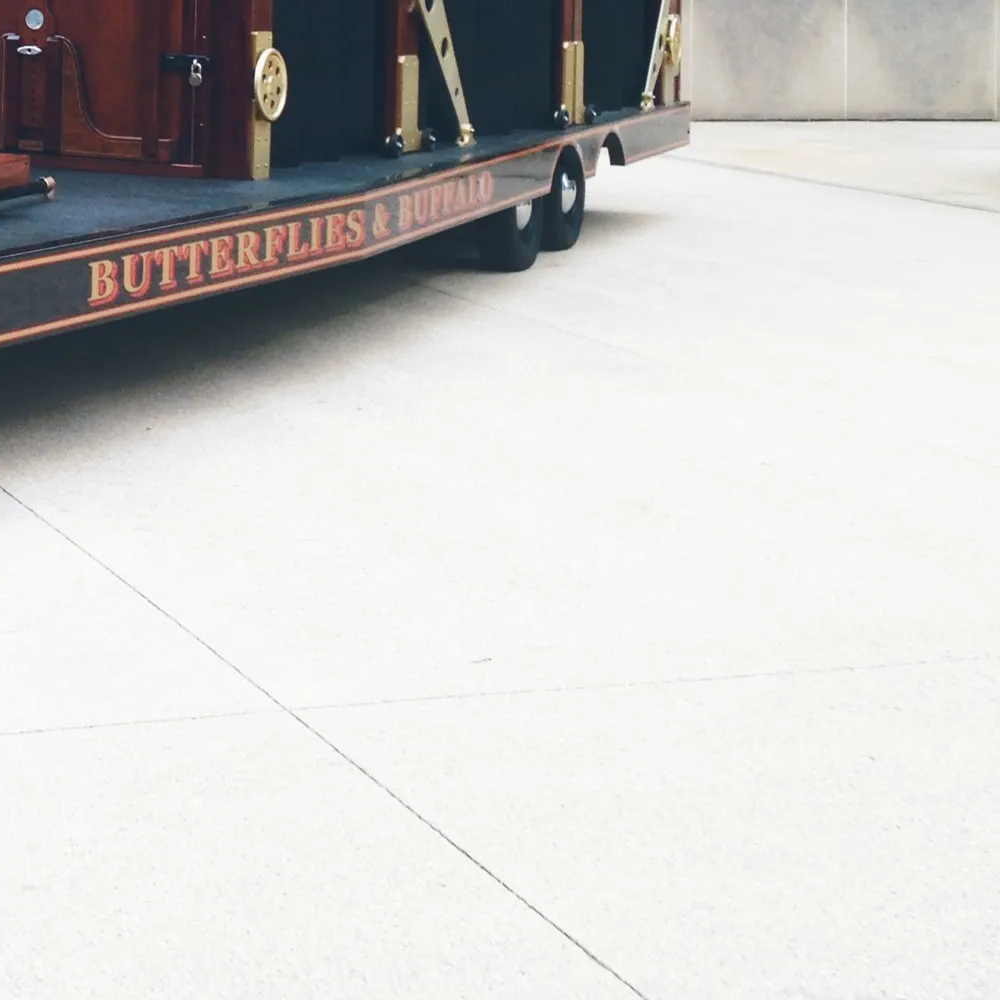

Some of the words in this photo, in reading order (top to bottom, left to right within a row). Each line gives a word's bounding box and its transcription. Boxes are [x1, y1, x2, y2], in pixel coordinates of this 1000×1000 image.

[87, 208, 366, 307] BUTTERFLIES
[372, 203, 391, 239] &
[398, 170, 495, 231] BUFFALO
